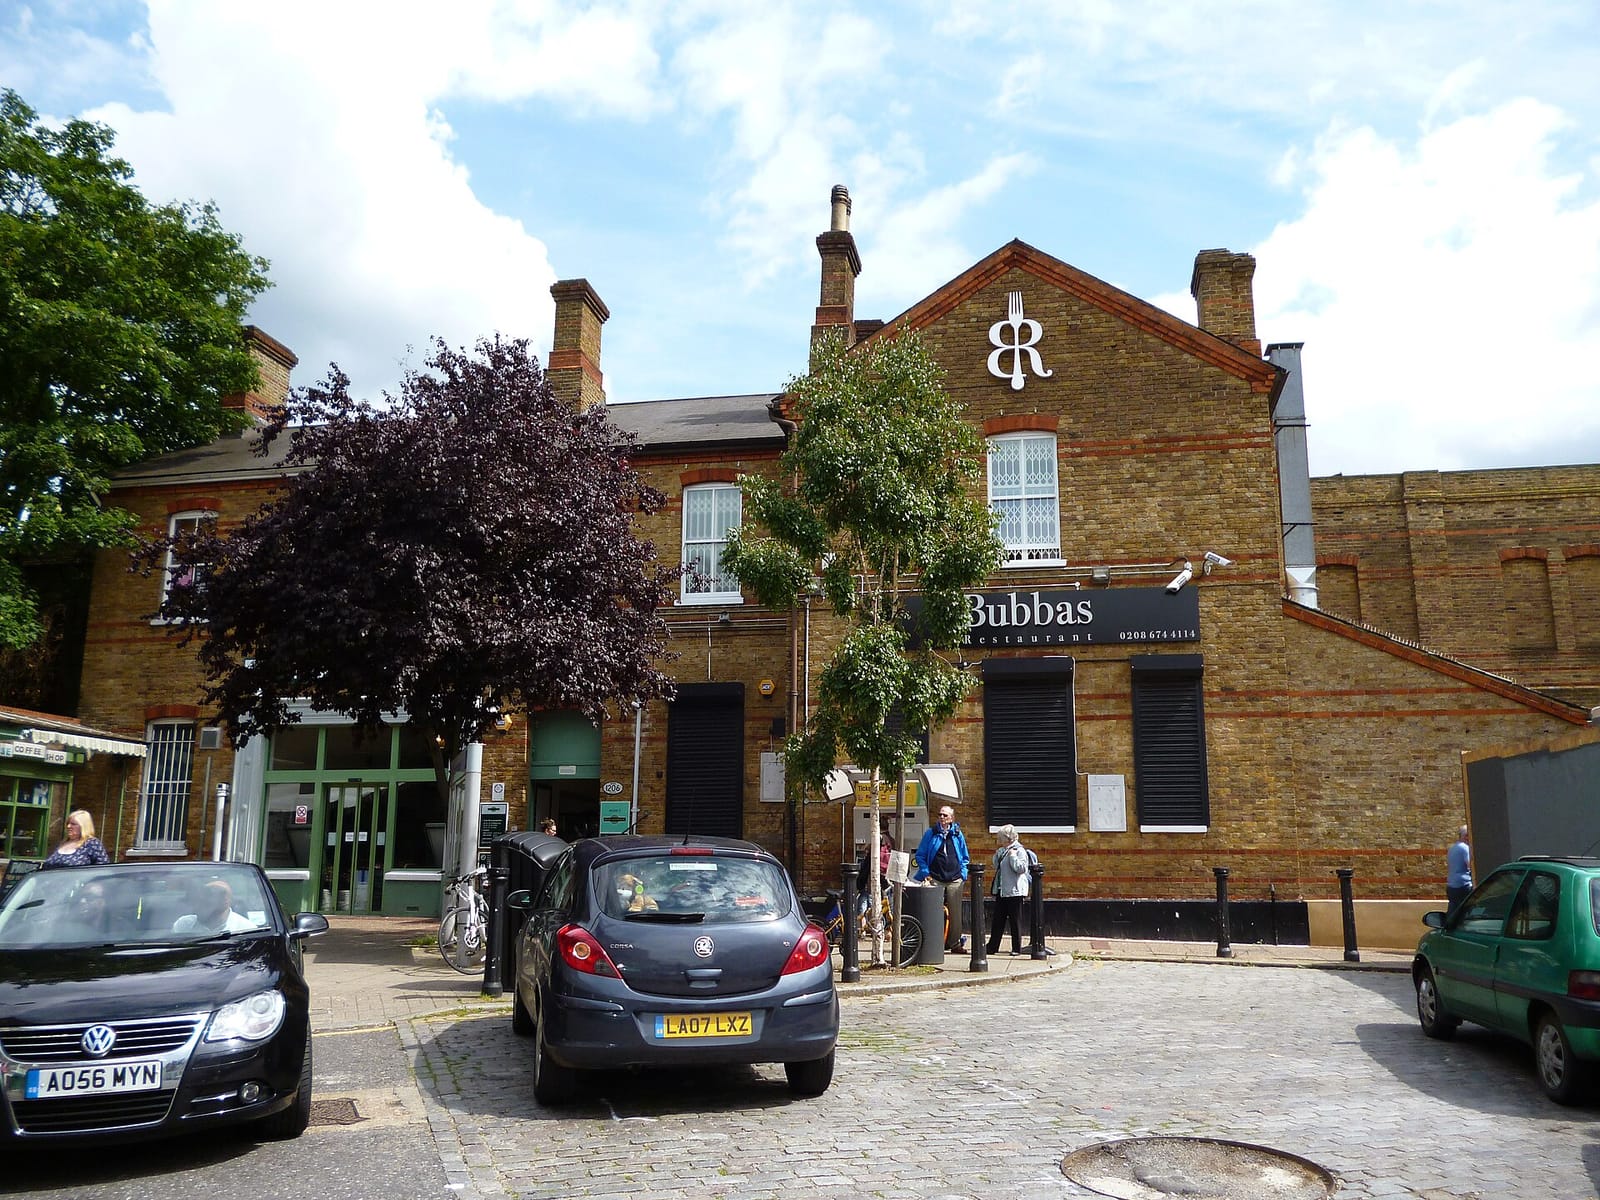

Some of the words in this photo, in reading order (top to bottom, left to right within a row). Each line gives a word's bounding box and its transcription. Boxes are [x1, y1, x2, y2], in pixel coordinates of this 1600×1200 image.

[964, 591, 1094, 628] Bubbas
[964, 633, 1093, 645] Restaurant
[1119, 631, 1147, 640] 0208
[1149, 630, 1167, 639] 674
[1170, 629, 1195, 638] 4114
[666, 1017, 711, 1034] LA07
[716, 1016, 749, 1033] LXZ
[46, 1068, 106, 1092] AO56
[112, 1064, 157, 1087] MYN
